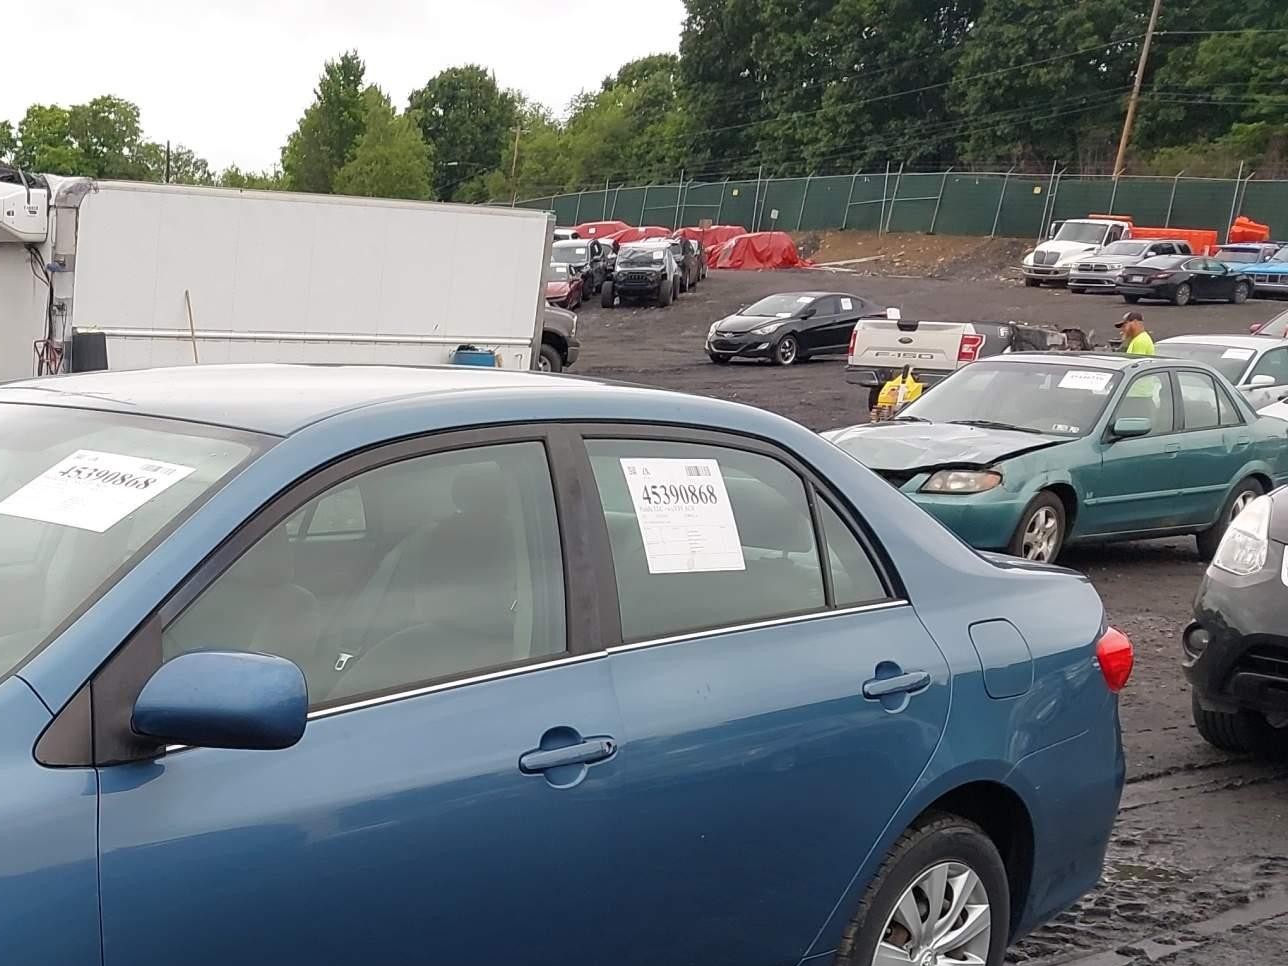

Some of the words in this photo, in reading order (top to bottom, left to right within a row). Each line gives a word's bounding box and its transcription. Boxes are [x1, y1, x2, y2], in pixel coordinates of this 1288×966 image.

[874, 351, 934, 360] F-150
[59, 464, 158, 490] 45390868
[642, 484, 718, 505] 45390868
